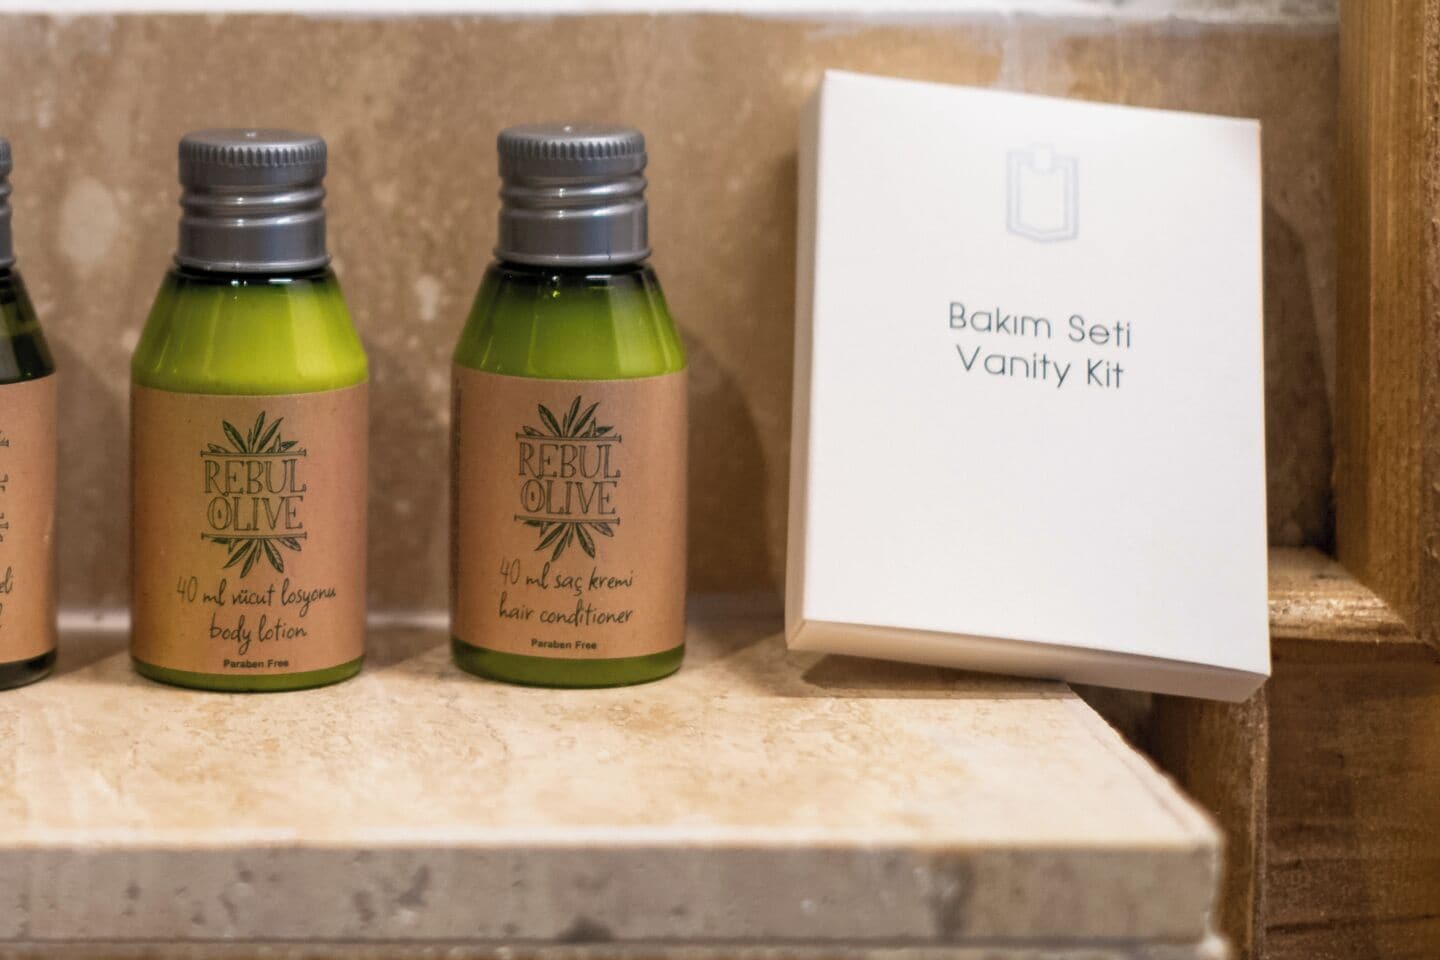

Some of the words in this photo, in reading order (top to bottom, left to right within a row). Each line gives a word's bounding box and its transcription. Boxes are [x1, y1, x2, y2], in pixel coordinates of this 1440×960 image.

[948, 301, 1052, 340] Bakım
[1067, 314, 1132, 349] Seti
[955, 344, 1071, 389] Vanity
[1086, 358, 1126, 389] Kit
[204, 458, 307, 496] REBUL
[517, 441, 621, 480] REBUL
[206, 495, 303, 531] OLIVE
[520, 478, 618, 516] OLIVE
[176, 575, 199, 603] 40
[202, 578, 226, 606] ml
[232, 583, 275, 607] vücut
[281, 577, 337, 618] losyonu
[499, 558, 520, 585] 40
[526, 561, 550, 590] ml
[553, 573, 583, 597] saç
[588, 566, 634, 591] kremi
[498, 590, 534, 620] hair
[540, 598, 633, 627] conditioner
[209, 612, 251, 656] body
[258, 613, 308, 643] lotion
[530, 638, 572, 649] Paraben
[575, 639, 597, 649] Free
[223, 658, 264, 669] Paraben
[267, 658, 289, 668] Free
